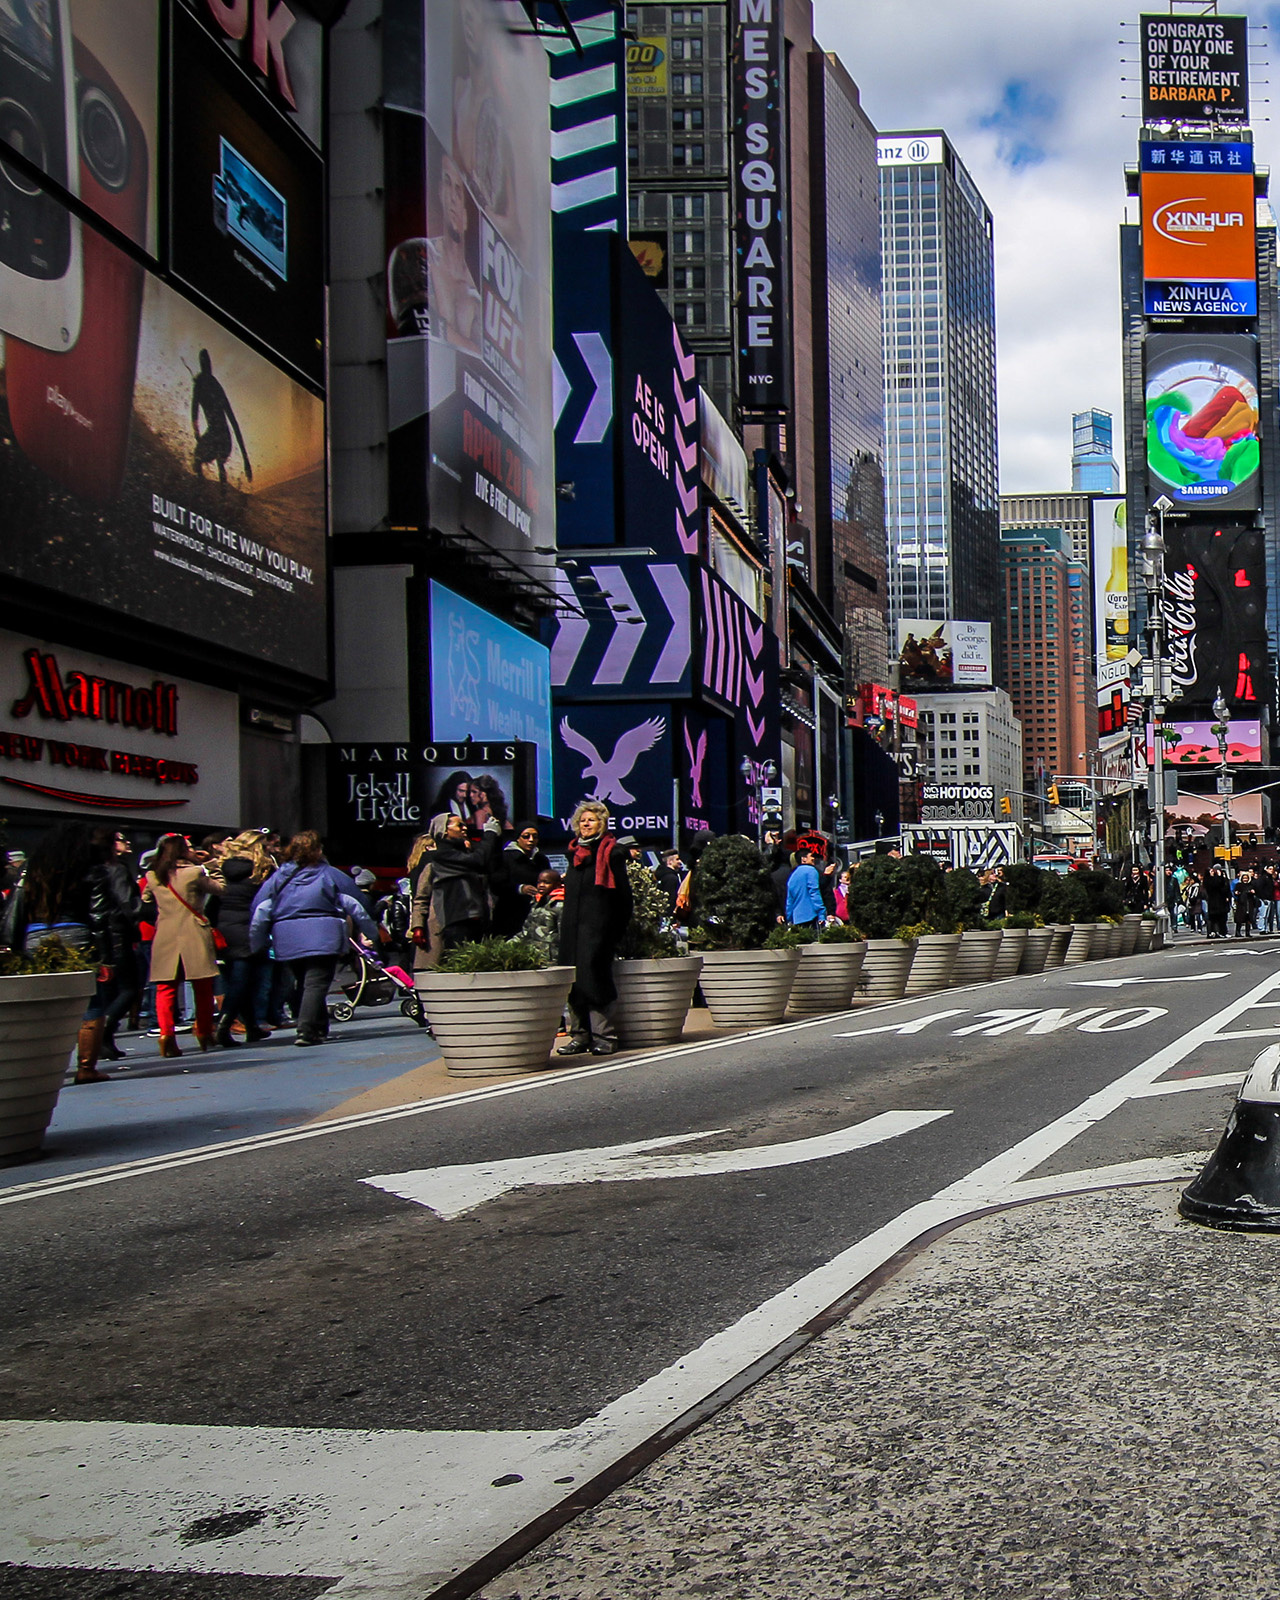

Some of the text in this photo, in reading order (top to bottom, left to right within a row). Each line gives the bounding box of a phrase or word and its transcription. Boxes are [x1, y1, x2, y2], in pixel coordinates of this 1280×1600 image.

[1147, 22, 1225, 39] CONGRATS
[1147, 38, 1234, 55] ON DAY ONE
[1148, 54, 1210, 70] OF YOUR
[1148, 70, 1240, 87] RETIREMENT.
[1149, 86, 1235, 102] BARBARA P.
[1151, 149, 1242, 166] 新华通讯社
[1166, 212, 1243, 227] XINHUA
[741, 123, 776, 347] SQUARE
[482, 213, 524, 326] FOX
[1168, 286, 1233, 301] XINHUA
[1153, 301, 1248, 313] NEWS AGENCY
[484, 290, 524, 369] UFC
[749, 375, 773, 384] NYC
[635, 373, 665, 435] AE IS
[463, 409, 503, 481] APRIL
[632, 412, 669, 480] OPEN!
[1181, 486, 1229, 495] SAMSUNG
[475, 471, 489, 504] LIVE
[495, 487, 507, 519] FREE
[516, 506, 531, 538] FOX
[152, 493, 314, 585] BUILT FOR THE WAY YOU PLAY.
[966, 625, 977, 635] By
[1070, 590, 1081, 676] NOVOTEL
[956, 634, 988, 644] George,
[961, 651, 984, 660] did it.
[486, 638, 535, 703] Merrill
[12, 649, 180, 736] Marriott
[340, 746, 517, 762] MARQUIS
[347, 772, 411, 804] Jekyll
[940, 786, 993, 799] HOT DOGS
[356, 797, 421, 828] Hyde
[620, 815, 669, 830] OPEN
